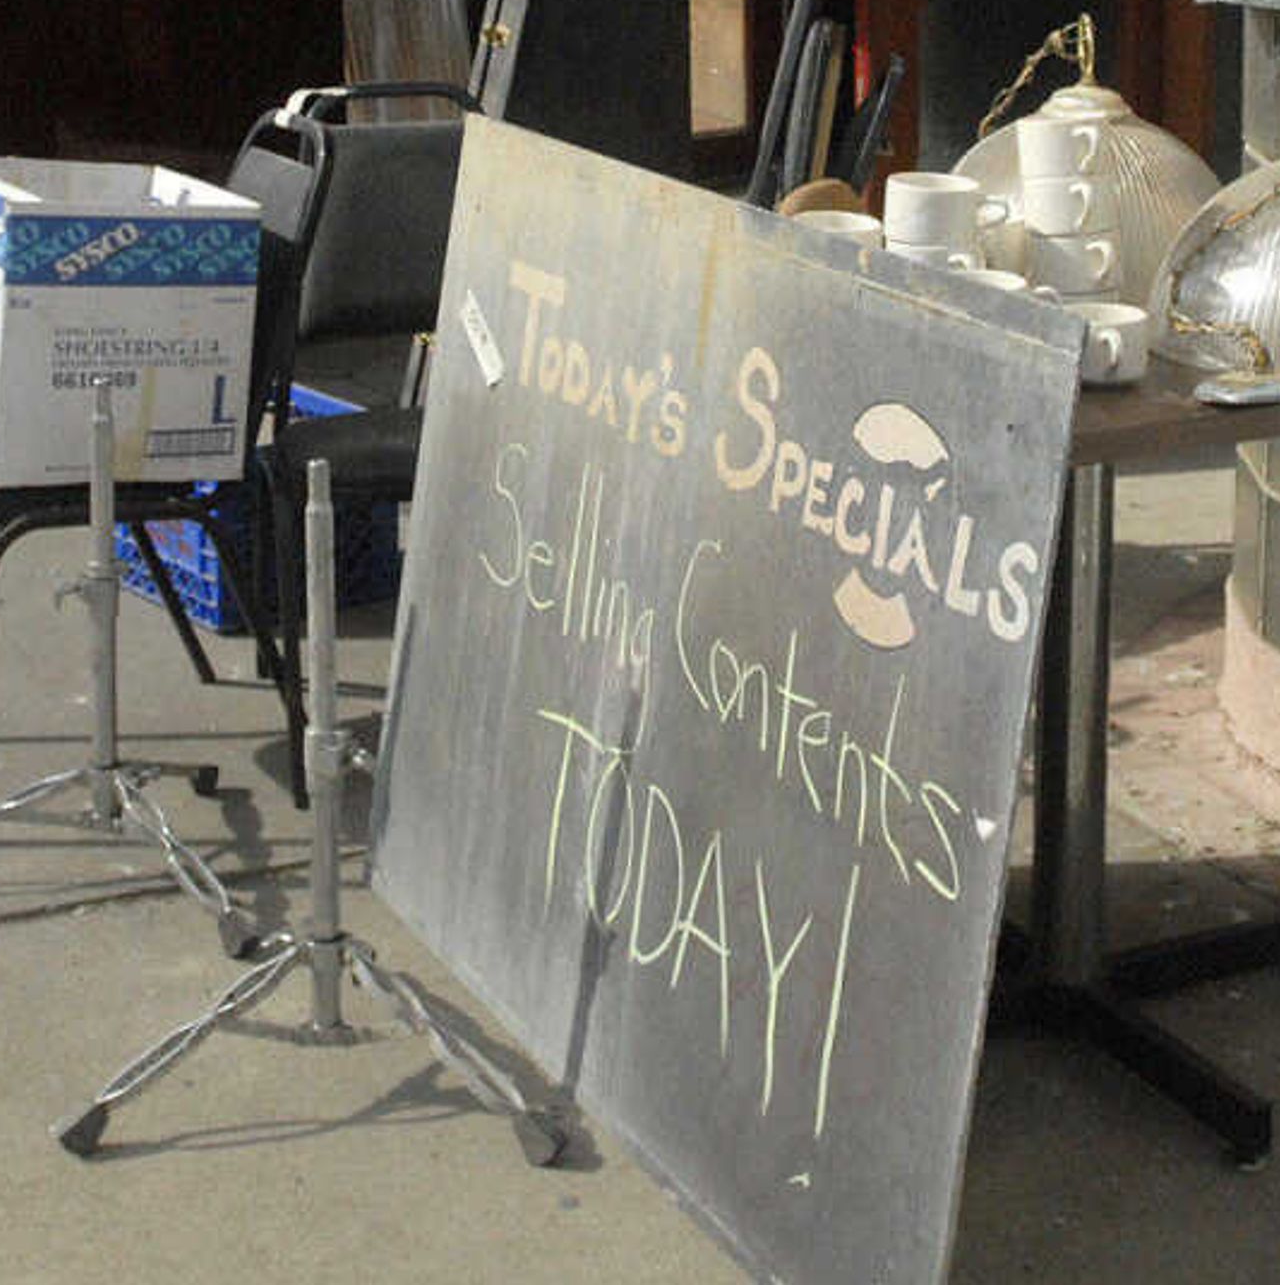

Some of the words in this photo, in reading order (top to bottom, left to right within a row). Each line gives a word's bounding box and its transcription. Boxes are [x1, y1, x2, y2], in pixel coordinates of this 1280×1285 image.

[55, 222, 140, 282] SYSCO
[214, 375, 238, 425] L
[509, 260, 688, 457] TODAY'S
[714, 347, 1039, 642] SPECIALS
[478, 443, 655, 753] Selling
[676, 539, 961, 900] Contents
